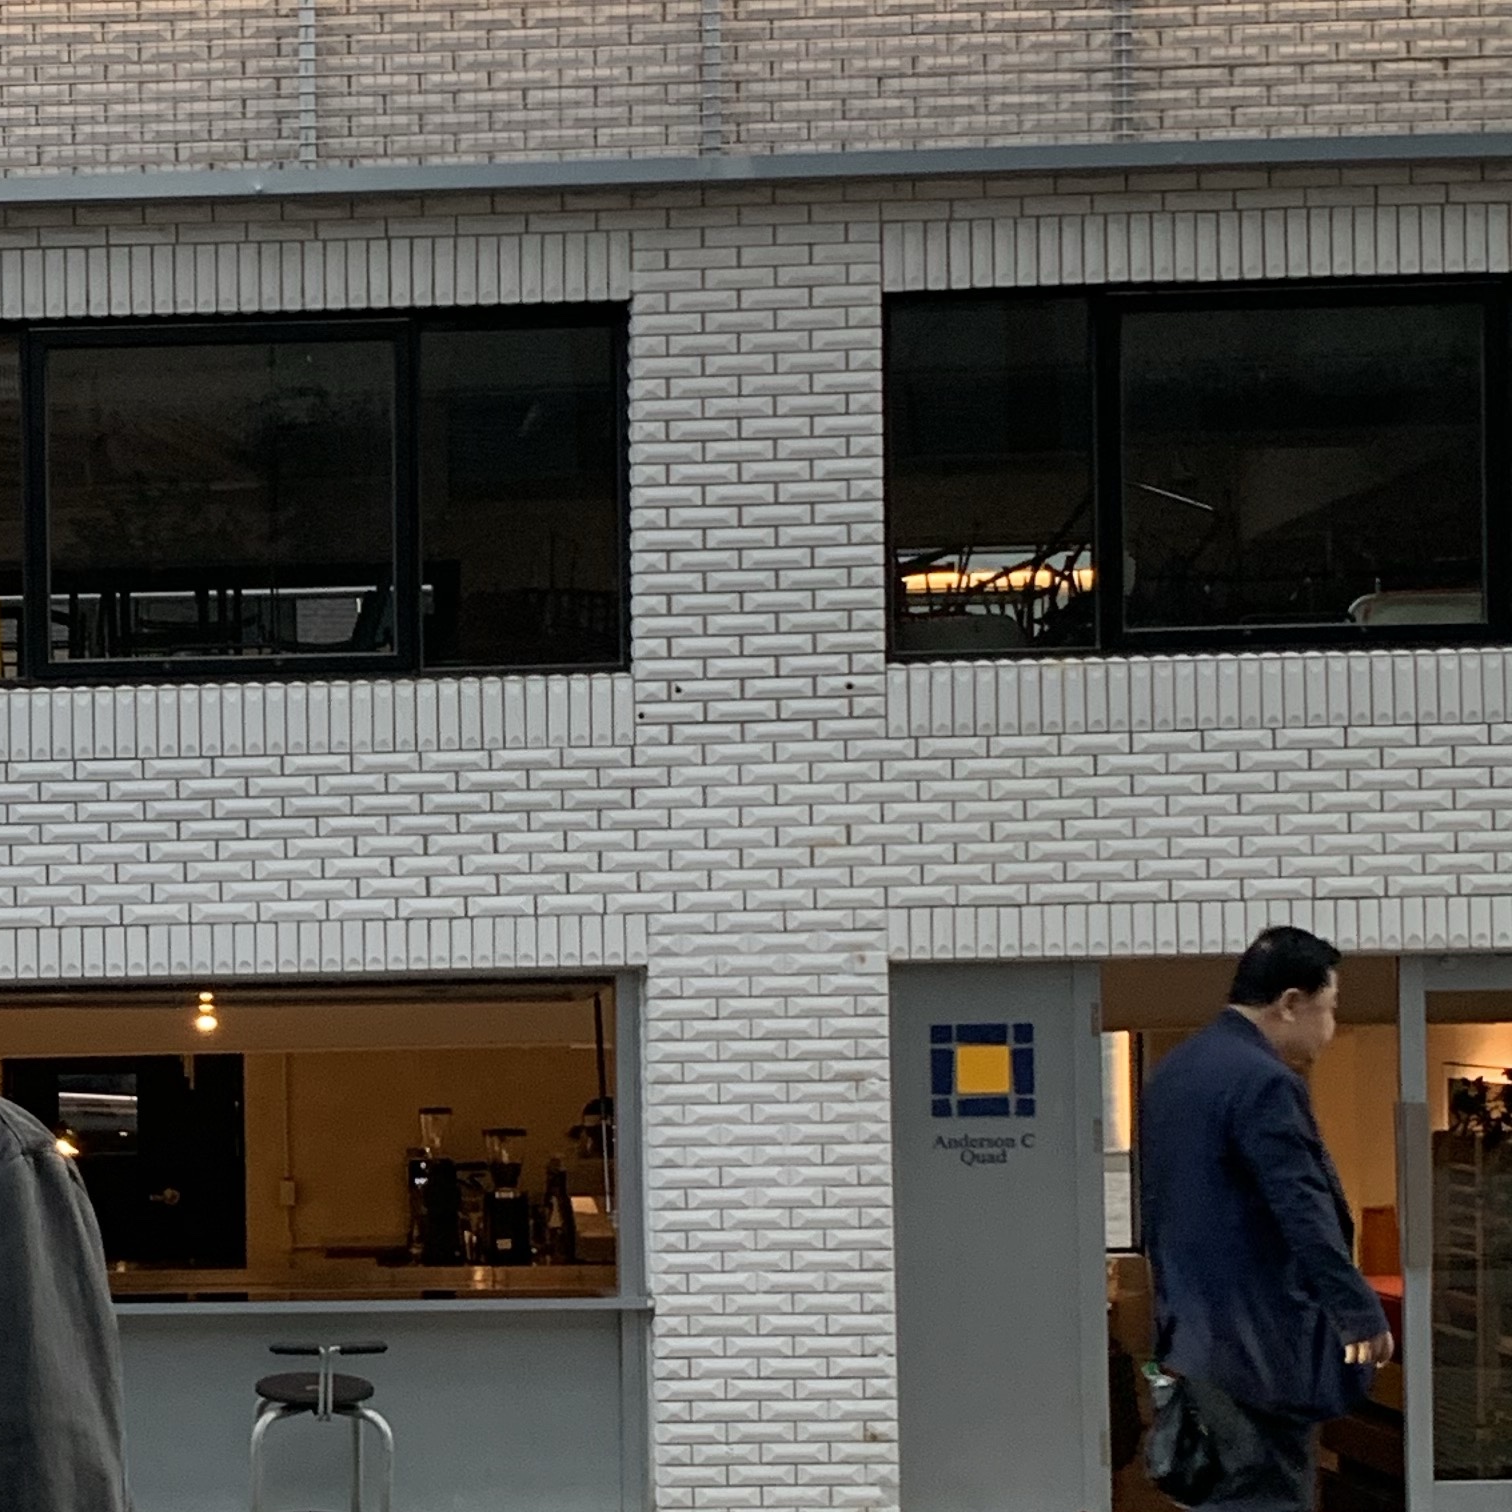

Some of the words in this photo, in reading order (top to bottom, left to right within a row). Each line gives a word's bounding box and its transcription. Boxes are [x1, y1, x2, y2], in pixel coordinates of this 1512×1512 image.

[934, 1134, 1016, 1149] Anderson
[1021, 1133, 1036, 1148] C
[960, 1149, 1008, 1166] Quad
